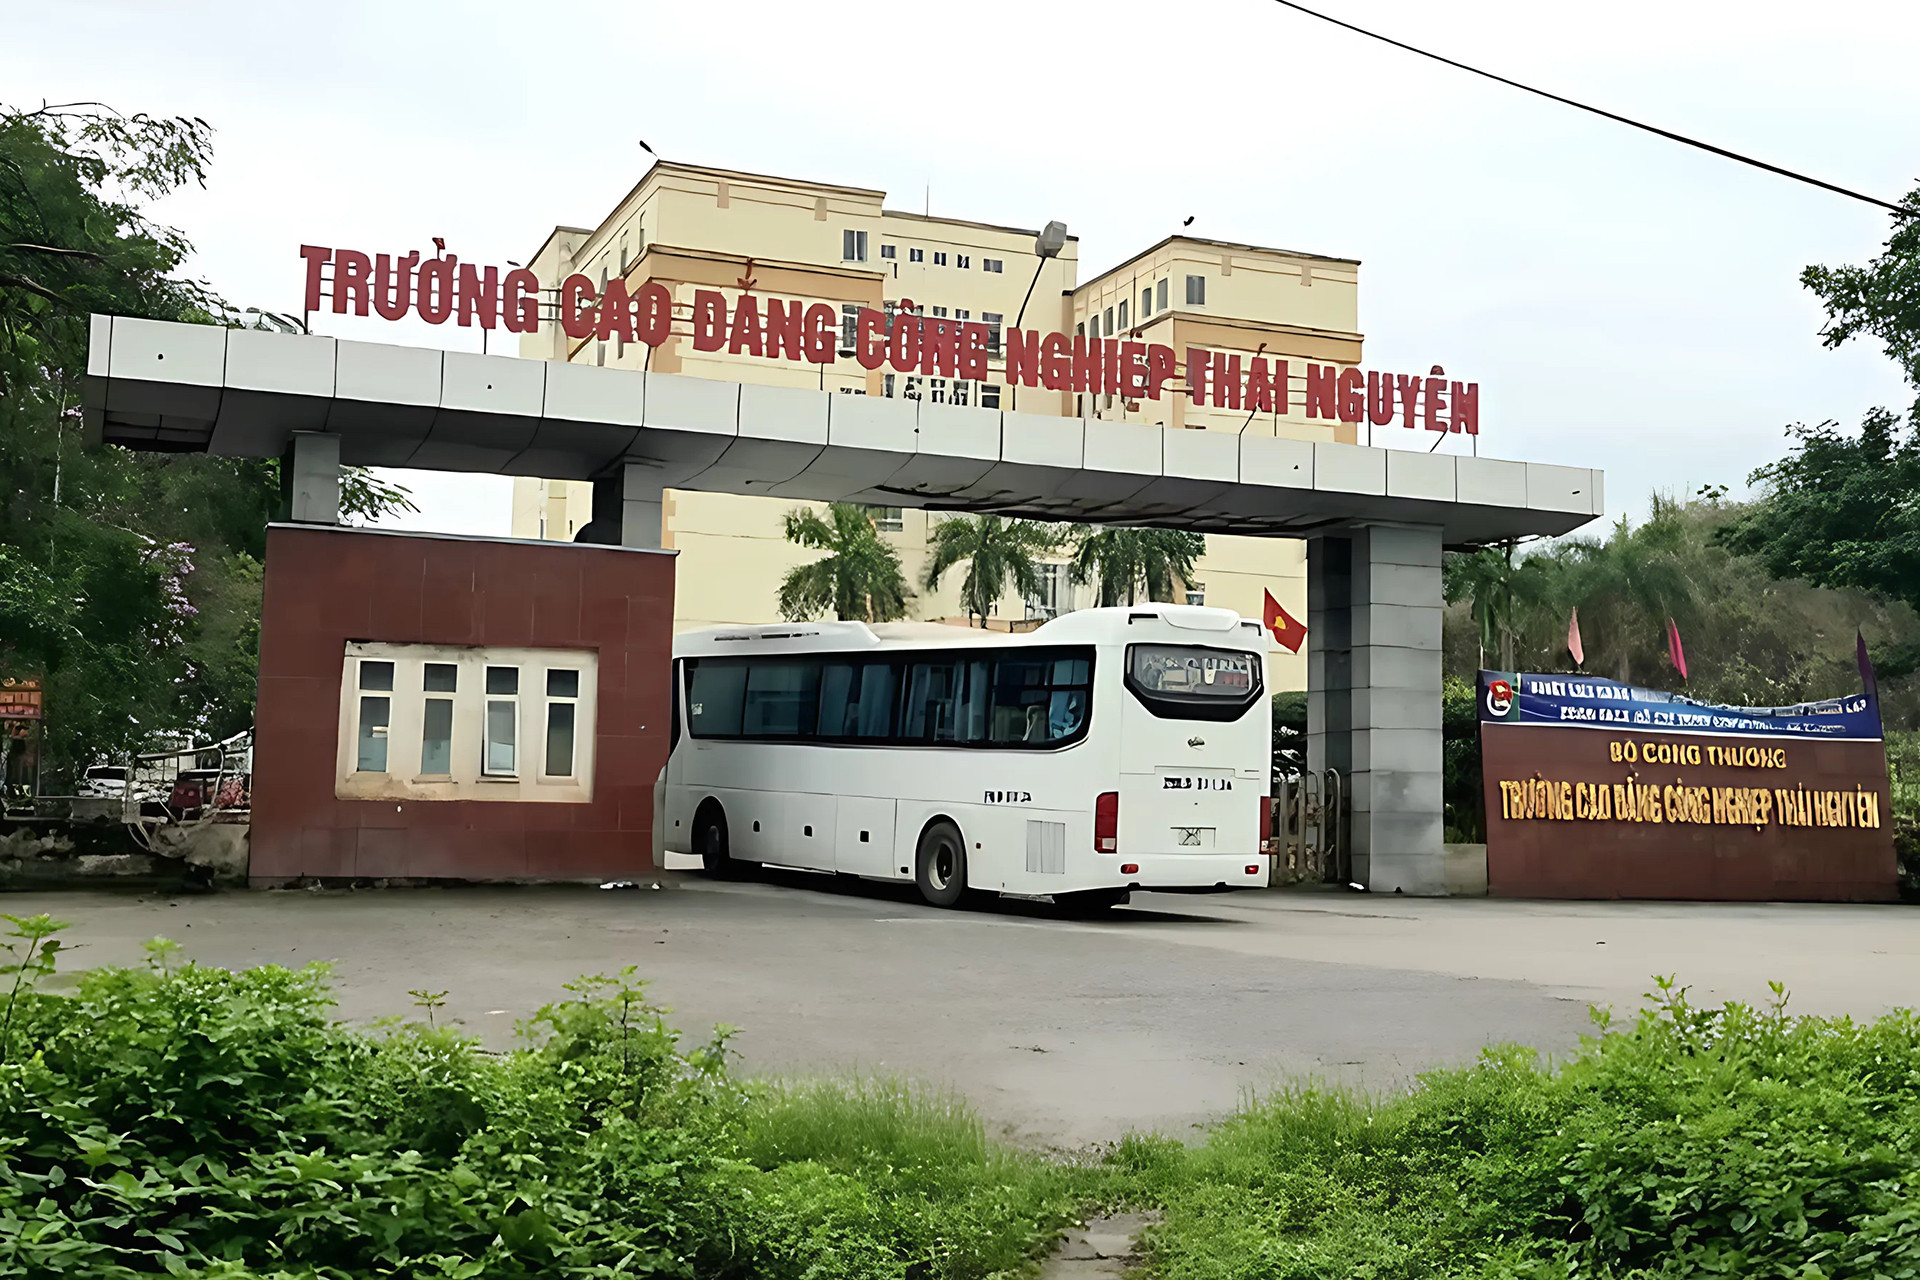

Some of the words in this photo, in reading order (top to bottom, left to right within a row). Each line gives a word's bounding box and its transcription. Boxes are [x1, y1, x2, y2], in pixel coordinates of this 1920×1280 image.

[300, 237, 539, 333] TRƯỜNG
[561, 273, 672, 348] CAO
[1187, 343, 1288, 414] THÁI
[1306, 365, 1479, 435] NGUYÊN
